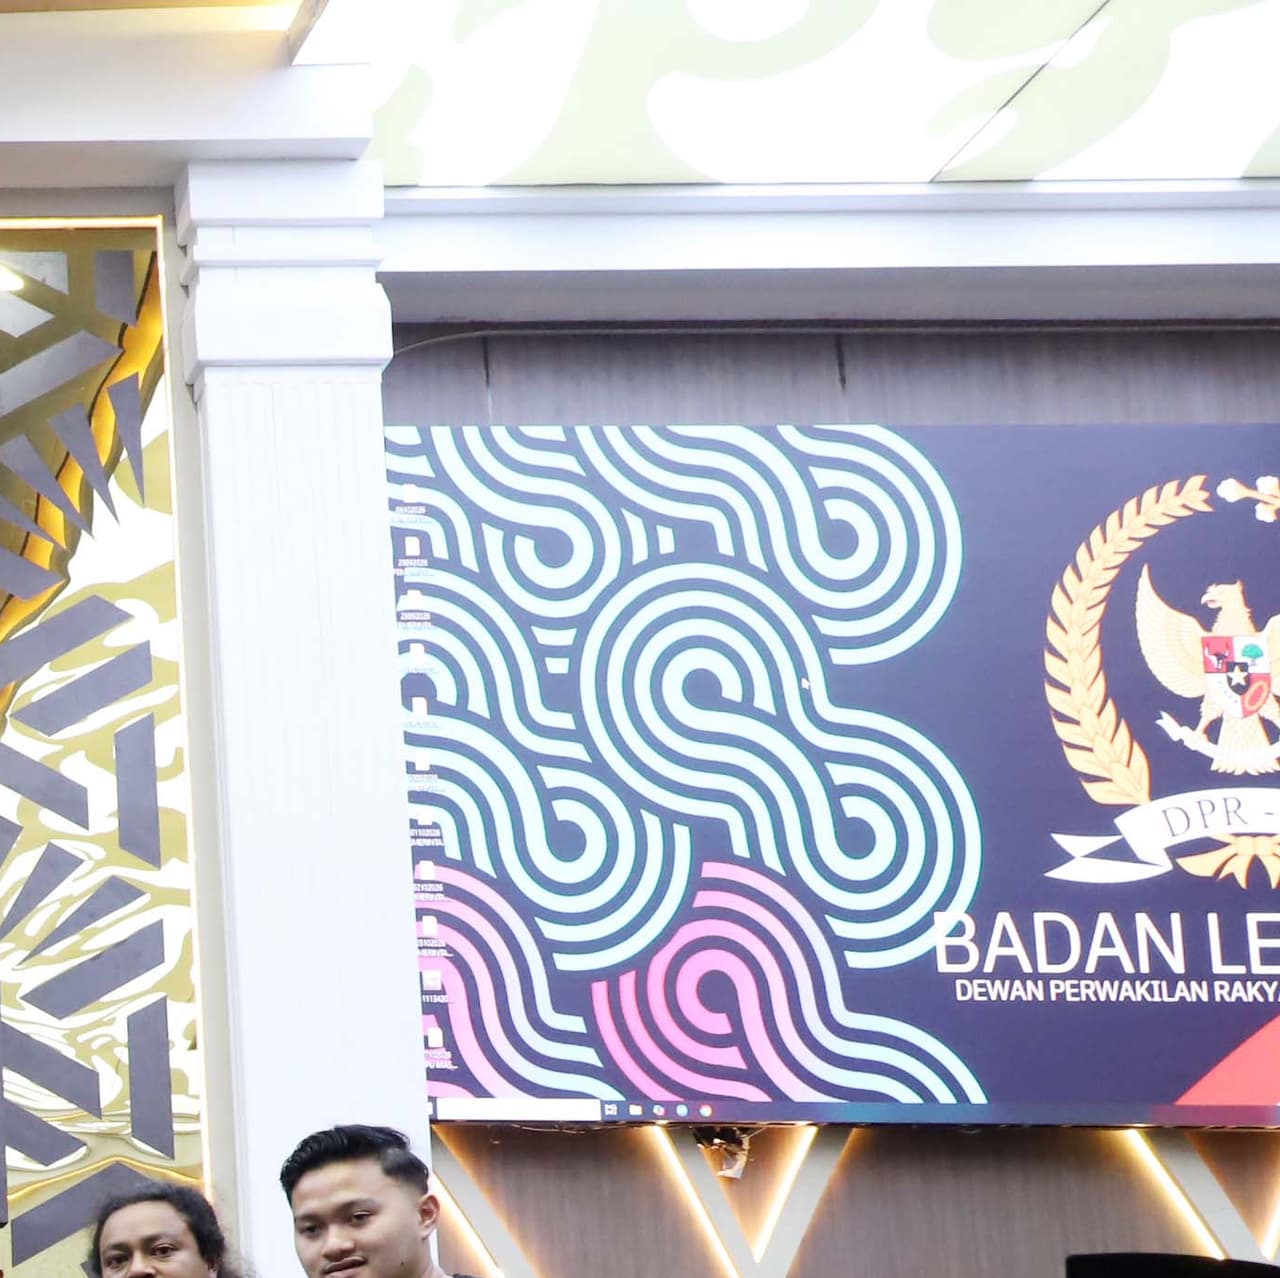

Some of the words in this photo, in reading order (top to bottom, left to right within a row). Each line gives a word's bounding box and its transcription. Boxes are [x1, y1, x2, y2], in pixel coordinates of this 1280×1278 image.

[1161, 796, 1249, 838] DPR
[934, 911, 1186, 975] BADAN
[955, 978, 1044, 1002] DEWAN
[1049, 979, 1208, 1003] PERWAKILAN
